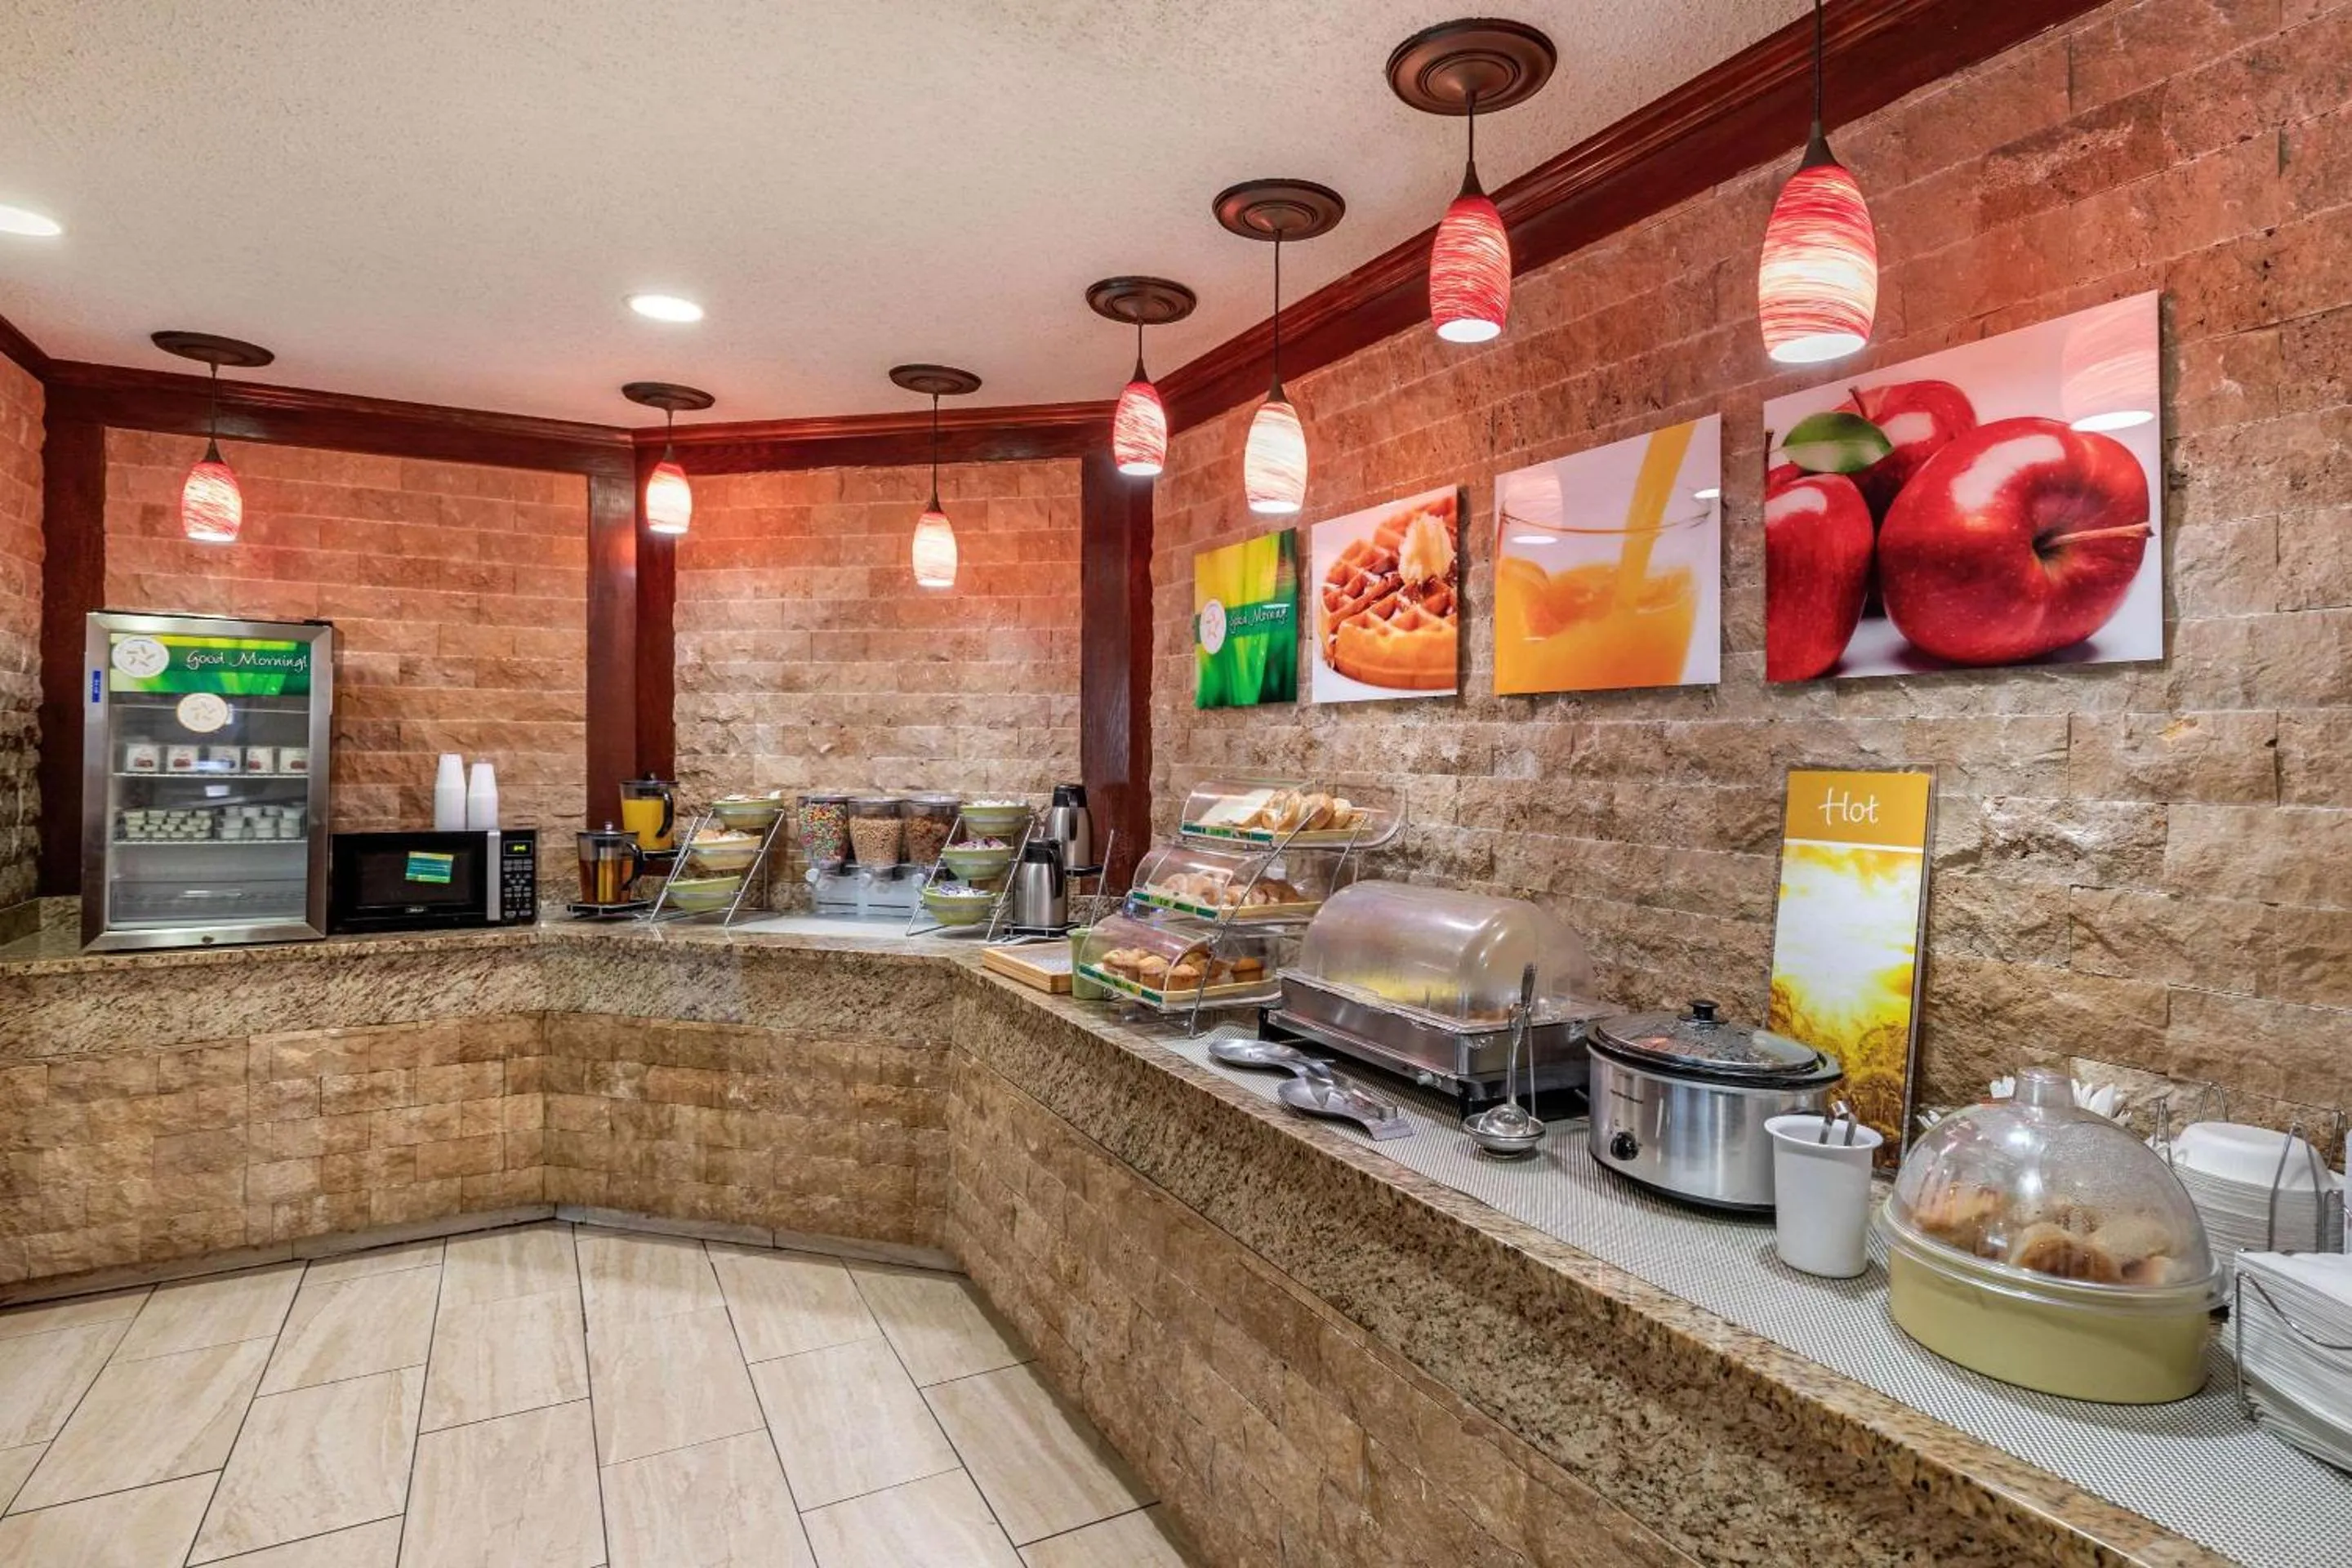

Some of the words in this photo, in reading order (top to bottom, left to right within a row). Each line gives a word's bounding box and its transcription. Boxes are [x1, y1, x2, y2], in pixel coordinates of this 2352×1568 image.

[185, 650, 225, 670] Good
[229, 652, 308, 673] Morning!
[1818, 788, 1879, 827] Hot
